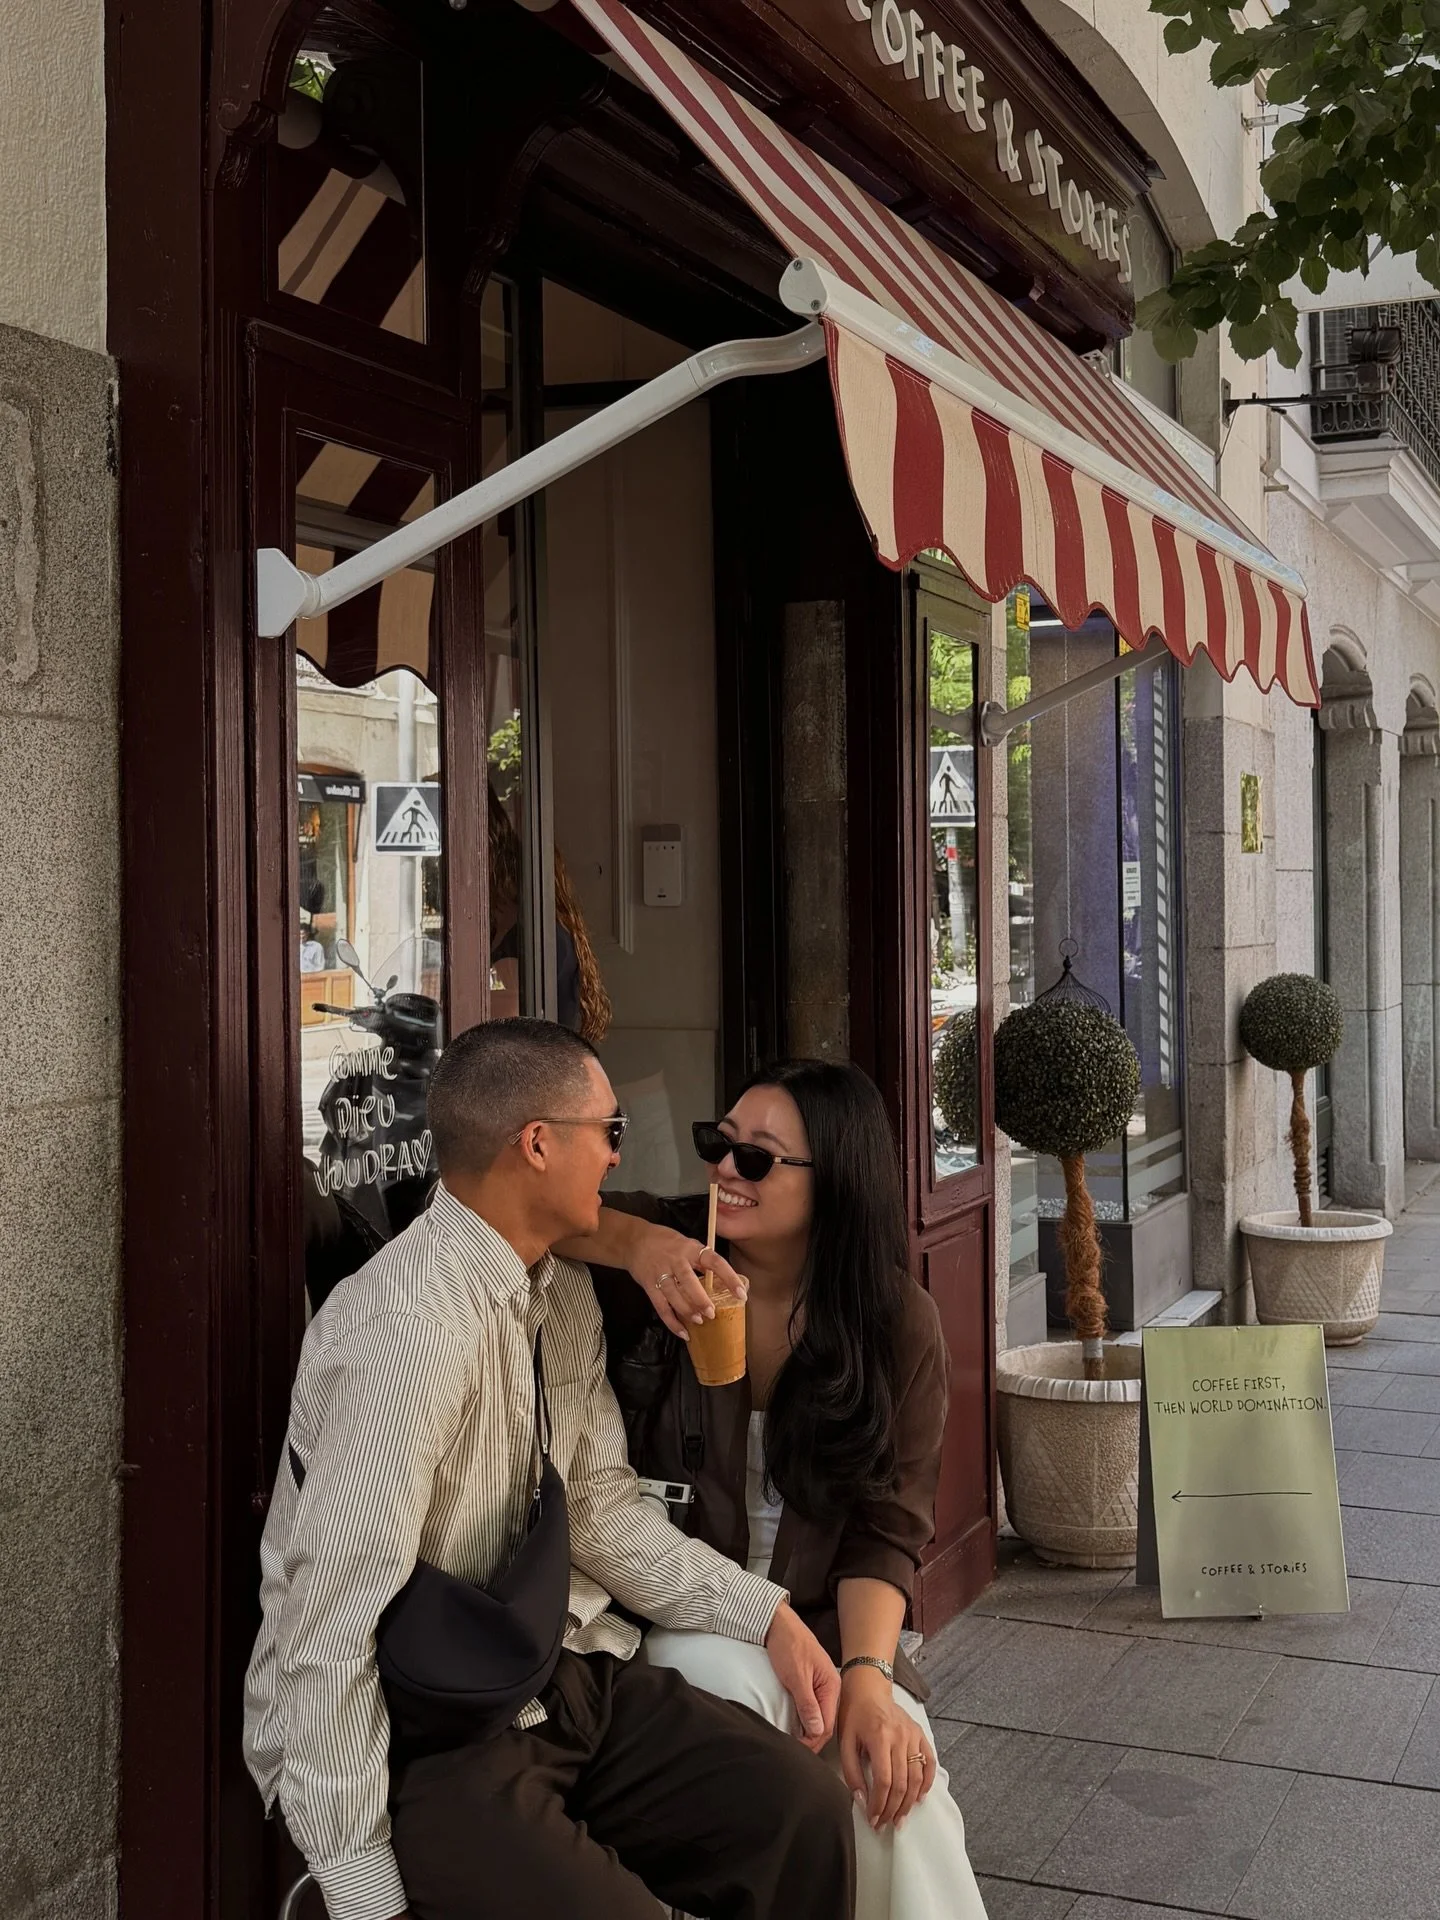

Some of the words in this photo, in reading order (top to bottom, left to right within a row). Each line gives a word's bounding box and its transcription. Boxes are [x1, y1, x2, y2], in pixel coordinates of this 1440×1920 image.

[993, 98, 1022, 182] &
[313, 1140, 415, 1197] VOUDRA
[1192, 1377, 1239, 1392] COFFEE
[1243, 1376, 1286, 1391] FIRST,
[1153, 1401, 1186, 1415] THEN
[1190, 1399, 1233, 1414] WORLD
[1201, 1564, 1243, 1577] COFFEE
[1248, 1563, 1255, 1575] &
